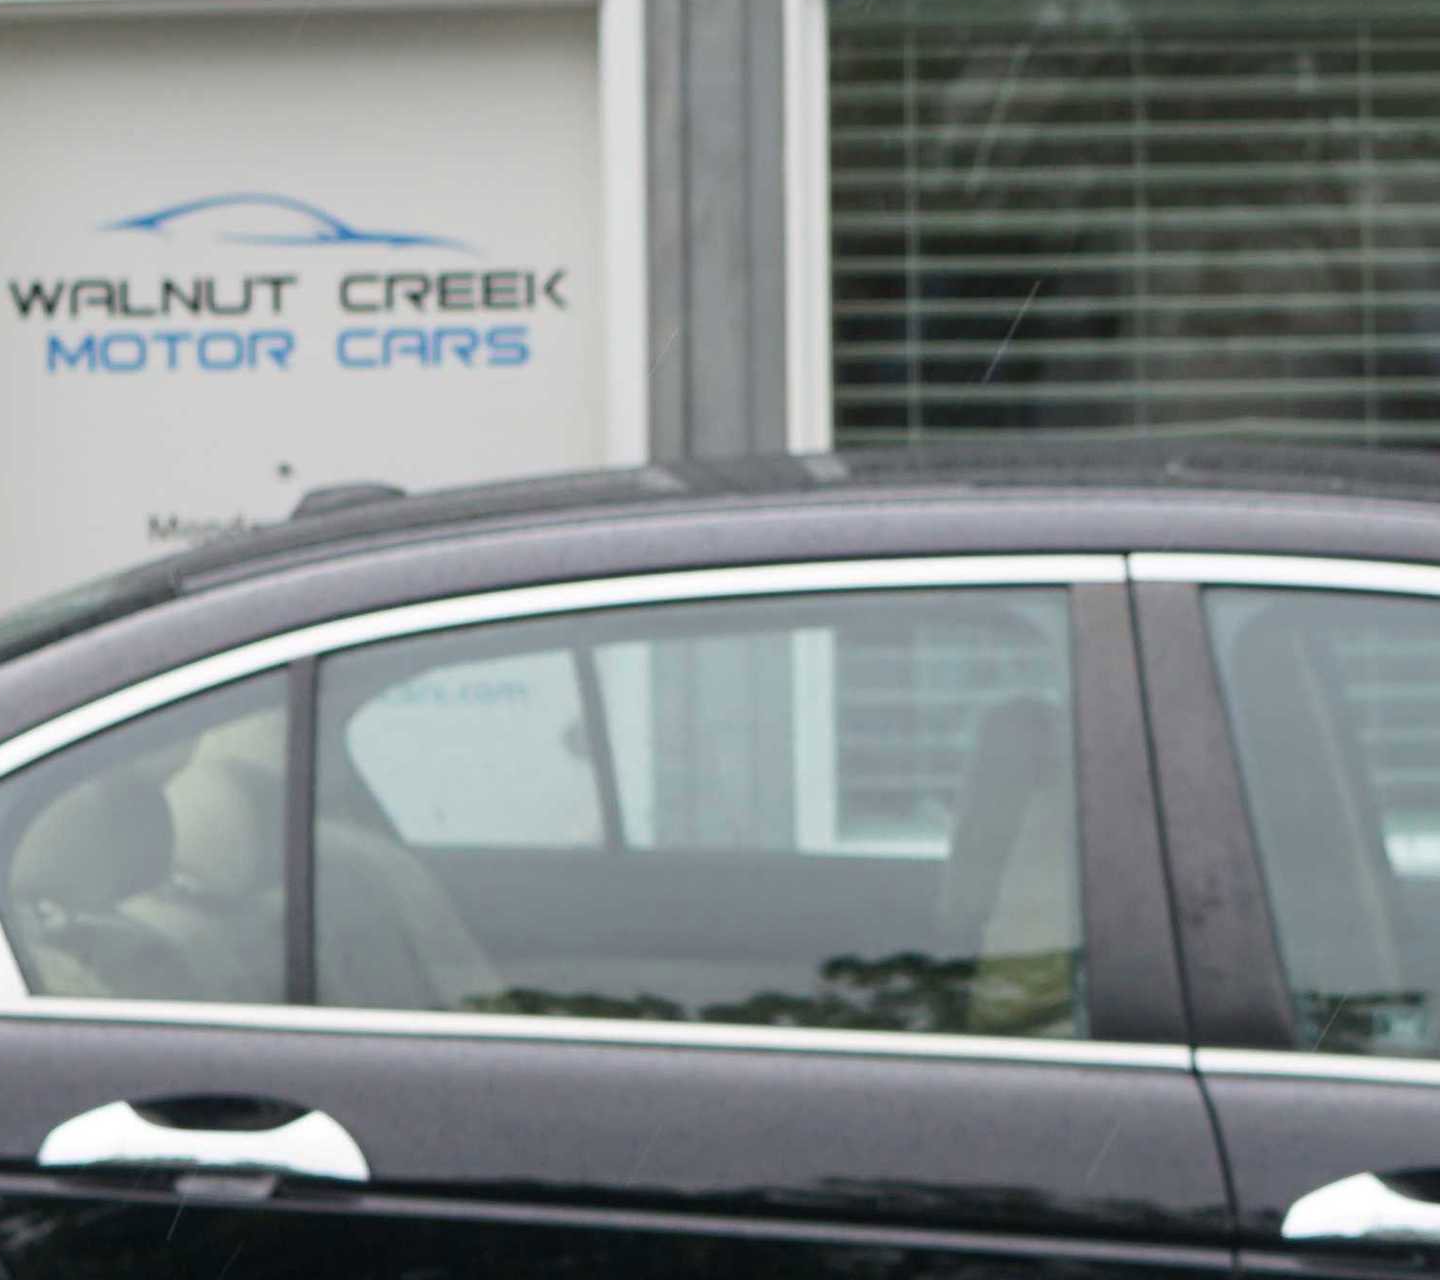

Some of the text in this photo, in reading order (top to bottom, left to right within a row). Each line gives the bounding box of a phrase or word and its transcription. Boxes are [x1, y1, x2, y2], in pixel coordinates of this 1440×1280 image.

[9, 270, 568, 318] WALNUT CREEK
[47, 325, 532, 373] MOTOR CARS
